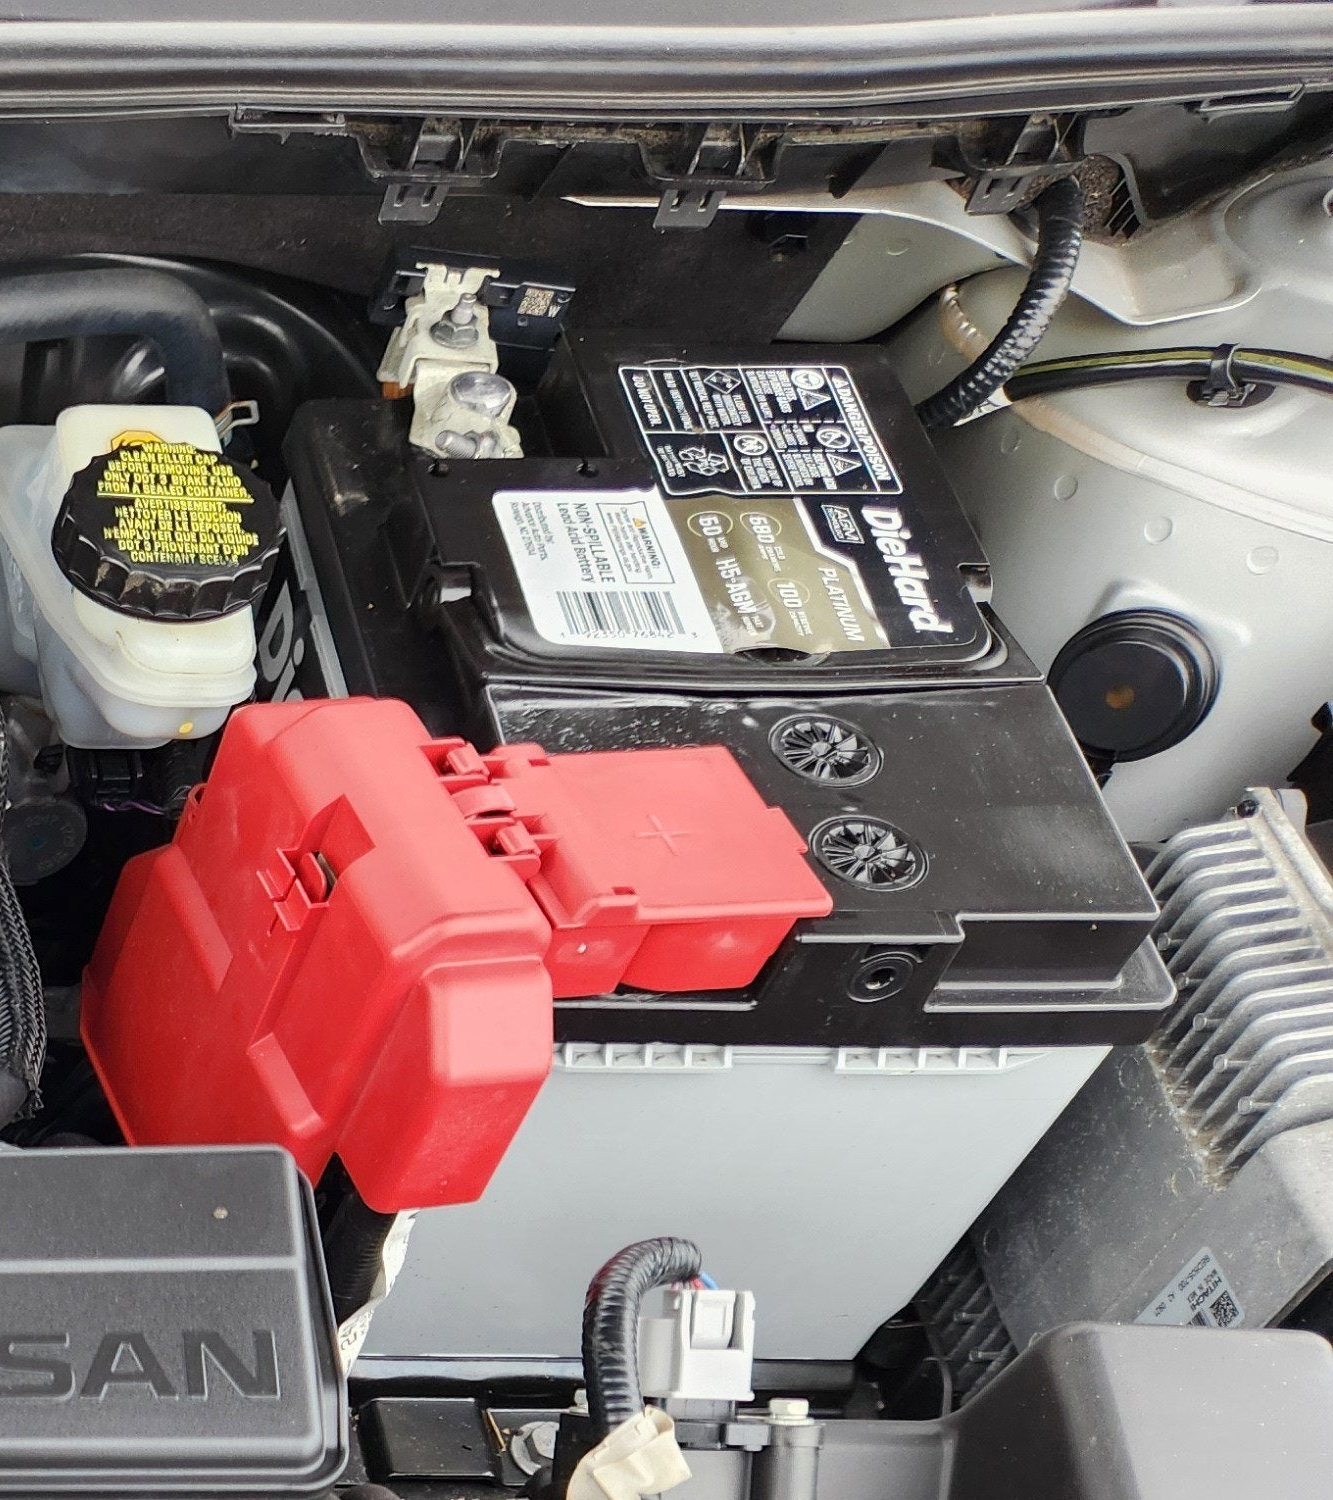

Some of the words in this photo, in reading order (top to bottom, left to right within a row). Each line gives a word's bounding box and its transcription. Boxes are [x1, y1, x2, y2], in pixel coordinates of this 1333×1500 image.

[631, 376, 647, 387] DO
[636, 388, 653, 402] NOT
[642, 404, 663, 426] OPEN.
[834, 388, 892, 480] DANGER/POISON
[108, 460, 149, 473] BEFORE
[213, 466, 233, 476] USE
[120, 451, 156, 462] CLEAN
[158, 453, 193, 464] FILLER
[195, 454, 217, 465] CAP
[98, 481, 129, 493] FROM
[132, 483, 140, 493] A
[143, 484, 183, 496] SEALED
[104, 471, 130, 483] ONLY
[134, 473, 155, 484] DOT
[160, 475, 168, 484] 3
[172, 476, 207, 486] BRAKE
[211, 477, 241, 487] FLUID
[115, 507, 171, 521] NETTOYER
[174, 510, 188, 521] LE
[190, 512, 241, 523] BOUCHON
[554, 502, 577, 524] Lead
[832, 508, 859, 539] AGM
[119, 518, 156, 530] AVANT
[159, 520, 172, 531] DE
[175, 521, 189, 532] LE
[563, 526, 585, 544] Acid
[747, 516, 776, 543] 680
[104, 527, 171, 542] N'EMPLOYER
[174, 531, 196, 543] QUE
[200, 532, 214, 543] DU
[217, 533, 259, 547] LIQUIDE
[118, 540, 140, 551] DOT
[144, 541, 151, 551] 3
[154, 541, 220, 554] PROVENANT
[223, 545, 248, 555] D'UN
[570, 502, 618, 582] NON-SPILLABLE
[131, 551, 195, 565] CONTENANT
[569, 547, 600, 583] Battery
[860, 505, 954, 636] DieHard
[713, 558, 758, 613] H5-AGM
[774, 582, 804, 607] 100
[815, 567, 867, 641] PLATINUM
[1188, 1275, 1222, 1313] HITACHI
